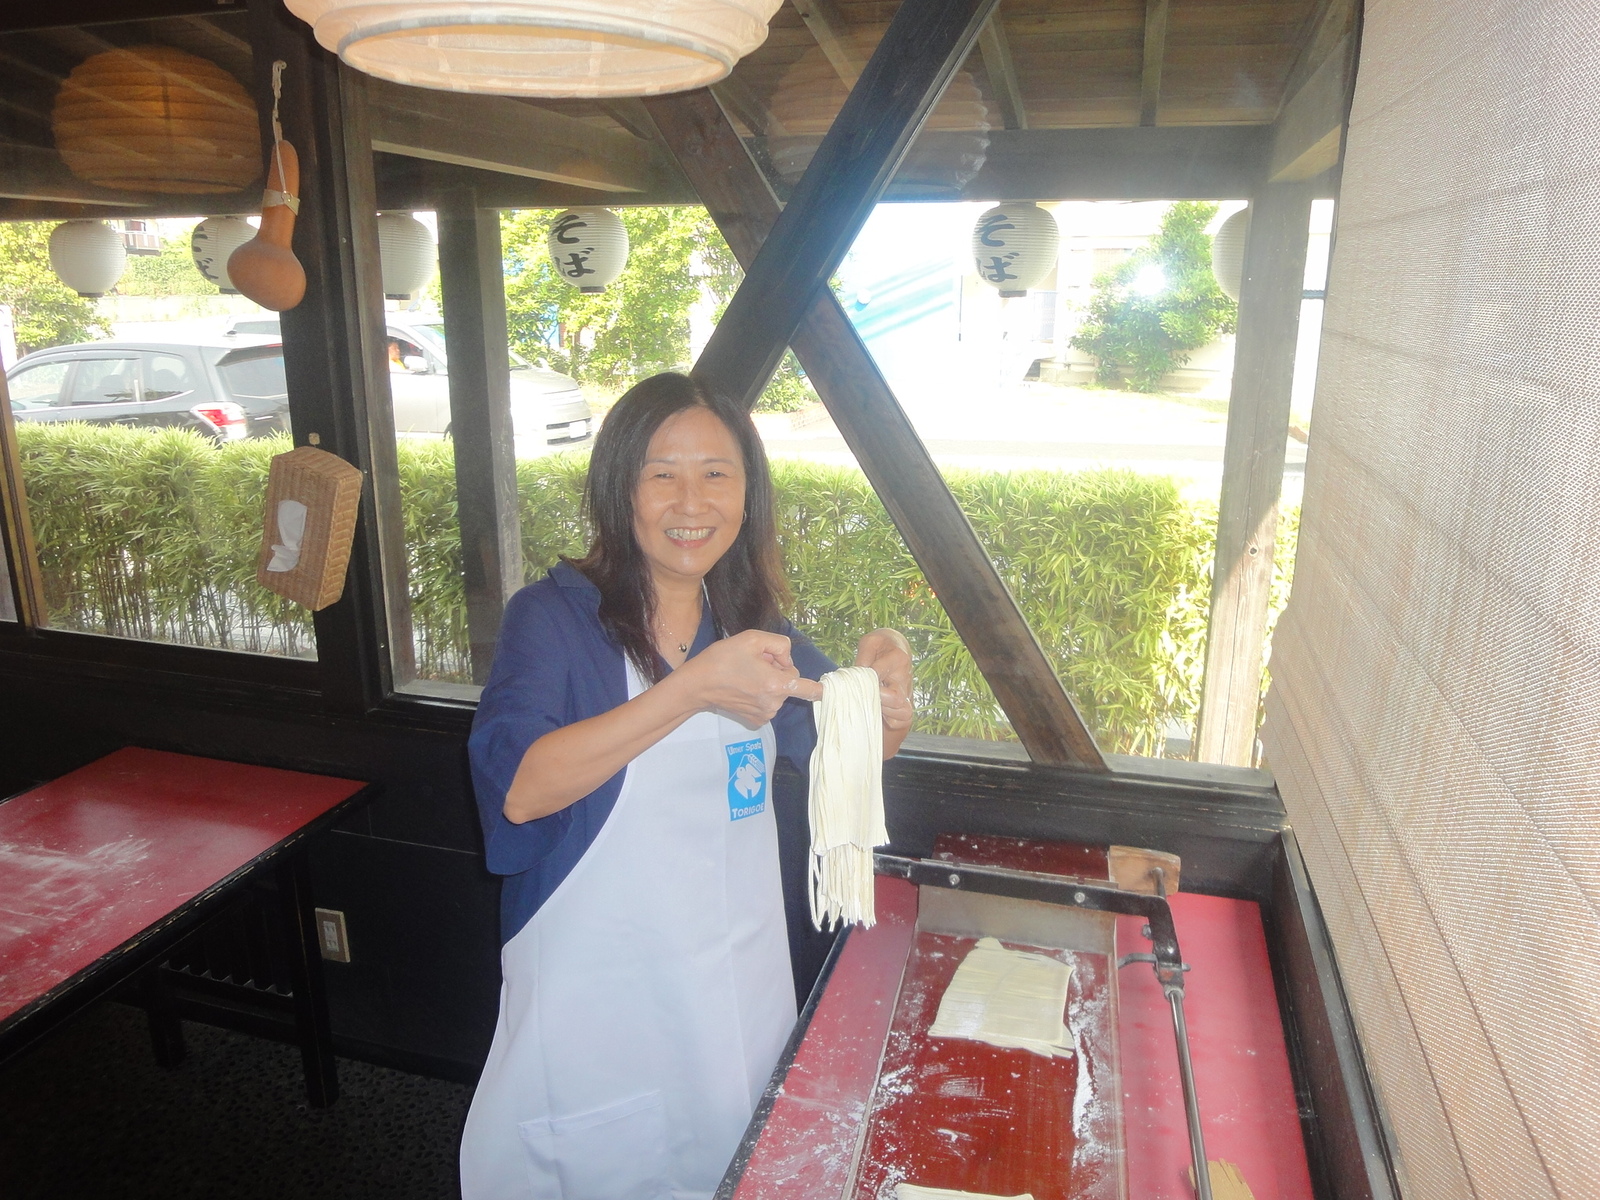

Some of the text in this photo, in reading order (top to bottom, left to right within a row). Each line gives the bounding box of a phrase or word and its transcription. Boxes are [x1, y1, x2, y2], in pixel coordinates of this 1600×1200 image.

[550, 214, 596, 278] そば
[974, 214, 1020, 283] そば
[732, 802, 765, 819] TORIGOE
